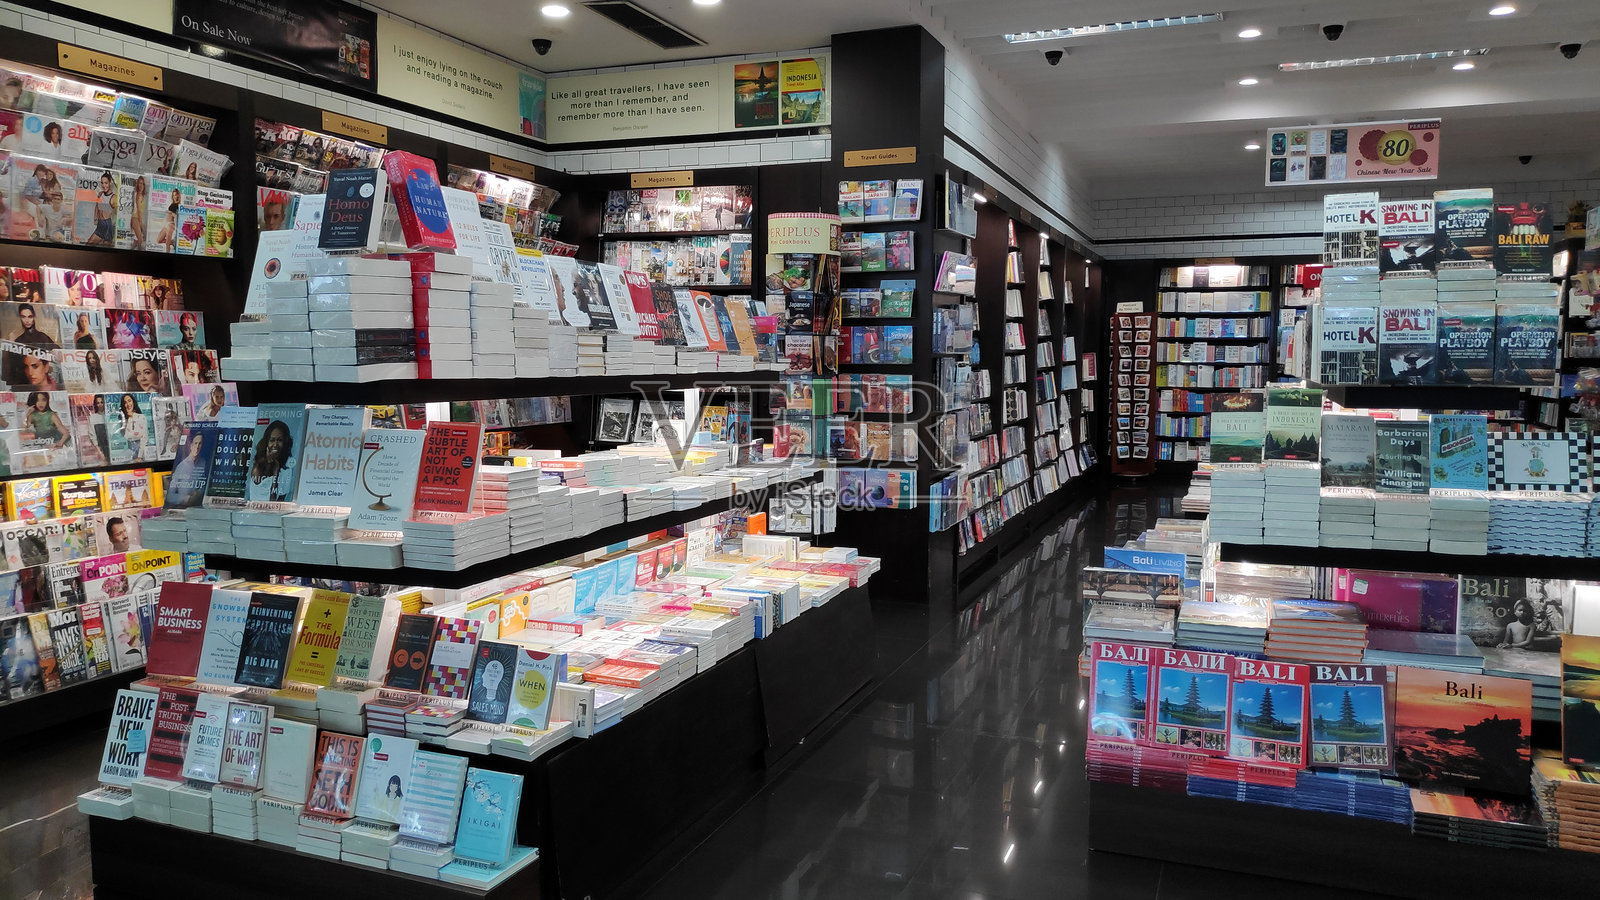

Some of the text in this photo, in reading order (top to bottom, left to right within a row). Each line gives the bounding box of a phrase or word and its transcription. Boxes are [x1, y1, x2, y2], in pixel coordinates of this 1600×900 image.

[182, 15, 252, 46] On Sale Now
[90, 58, 136, 78] Magazines
[399, 46, 414, 60] just
[416, 52, 437, 70] enjoy
[440, 60, 457, 78] lying
[459, 69, 468, 78] on
[470, 72, 481, 83] the
[483, 76, 503, 90] couch
[406, 64, 421, 76] and
[424, 69, 452, 88] reading
[460, 82, 494, 100] magazine.
[786, 74, 818, 82] INDONESIA
[551, 79, 710, 99] Like all great travellers, I have seen
[570, 93, 689, 109] more than I remember, and
[558, 103, 705, 122] remember more than I have seen.
[341, 122, 370, 135] Magazines
[1383, 139, 1409, 157] 80
[78, 180, 98, 190] 2019
[204, 197, 224, 205] Weight
[328, 198, 370, 211] Homo
[414, 195, 442, 208] HUMAN
[179, 206, 206, 214] Prevention
[416, 206, 448, 220] NATURE
[1381, 204, 1420, 213] SNOWING
[1422, 202, 1433, 211] IN
[330, 211, 364, 223] Deus
[1326, 210, 1377, 226] HOTEL K
[1384, 212, 1430, 225] BALI
[1447, 212, 1490, 221] OPERATION
[1438, 220, 1488, 230] PLAYBOY
[888, 237, 908, 246] Japan
[1498, 234, 1524, 246] BALI
[1525, 234, 1550, 245] RAW
[520, 258, 545, 268] BLOCKCHAIN
[521, 267, 547, 275] REVOLUTION
[1382, 308, 1436, 319] SNOWING IN
[1386, 318, 1432, 332] BALI
[1324, 326, 1377, 344] HOTEL K
[1449, 331, 1492, 341] OPERATION
[1510, 331, 1555, 341] OPERATION
[1440, 338, 1489, 349] PLAYBOY
[1500, 338, 1552, 349] PLAYBOY
[259, 410, 303, 419] BECOMING
[1272, 416, 1316, 426] INDONESIA
[430, 428, 450, 436] THE
[1326, 424, 1372, 432] MATARAM
[218, 434, 254, 442] BILLION
[305, 432, 362, 450] Atomic
[370, 434, 417, 444] CRASHED
[428, 437, 468, 448] SUBTLE
[1390, 437, 1416, 447] Days
[216, 446, 252, 454] DOLLAR
[427, 448, 466, 457] ART OF
[215, 458, 250, 467] WHALE
[305, 454, 356, 472] Habits
[426, 456, 448, 466] NOT
[424, 466, 461, 477] GIVING
[1384, 470, 1422, 478] William
[110, 478, 148, 491] TRAVELER
[422, 476, 430, 485] A
[1381, 478, 1425, 488] Finnegan
[308, 489, 327, 497] James
[378, 514, 398, 523] Tooze
[1132, 556, 1182, 568] Bali LIVING
[1462, 578, 1510, 598] Bali
[160, 606, 192, 617] SMART
[251, 606, 293, 619] REINVENTING
[158, 618, 202, 629] BUSINESS
[316, 622, 332, 631] THE
[348, 616, 379, 630] WEST
[298, 626, 341, 650] Formula
[244, 657, 258, 667] BIG
[260, 660, 279, 670] DATA
[1164, 650, 1226, 671] БАЛИ
[1240, 661, 1296, 682] BALI
[1316, 666, 1374, 682] BALI
[519, 678, 546, 691] WHEN
[1445, 680, 1484, 700] Bali
[162, 692, 176, 700] THE
[378, 690, 407, 700] PERIPLUS
[116, 694, 155, 720] BRAVE
[170, 703, 190, 712] POST-
[158, 712, 182, 721] TRUTH
[158, 721, 193, 732] BUSINESS
[199, 724, 223, 737] FUTURE
[197, 736, 220, 747] CRIMES
[228, 729, 262, 750] THE ART
[322, 736, 360, 757] THIS IS
[225, 748, 236, 764] OF
[237, 751, 254, 768] WAR
[468, 816, 502, 828] IKIGAI
